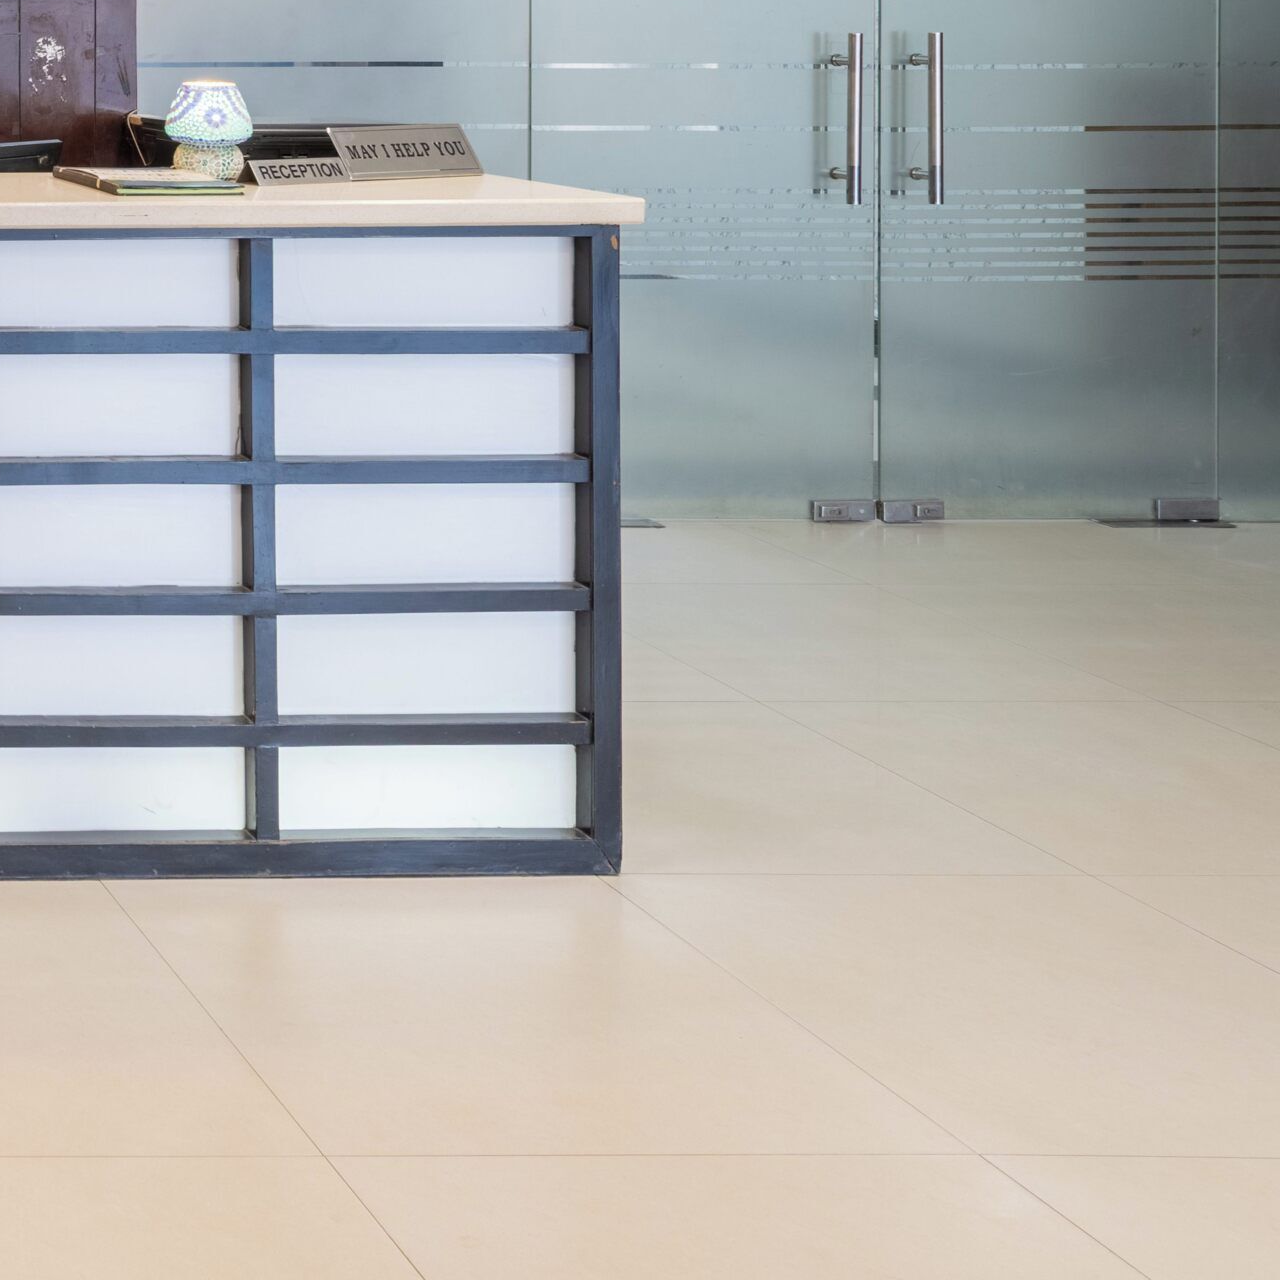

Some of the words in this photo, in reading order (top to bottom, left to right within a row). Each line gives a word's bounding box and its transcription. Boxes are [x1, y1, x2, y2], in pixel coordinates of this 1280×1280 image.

[344, 143, 380, 160] MAY
[381, 143, 391, 159] I
[391, 141, 431, 158] HELP
[432, 140, 467, 156] YOU
[258, 162, 344, 180] RECEPTION
